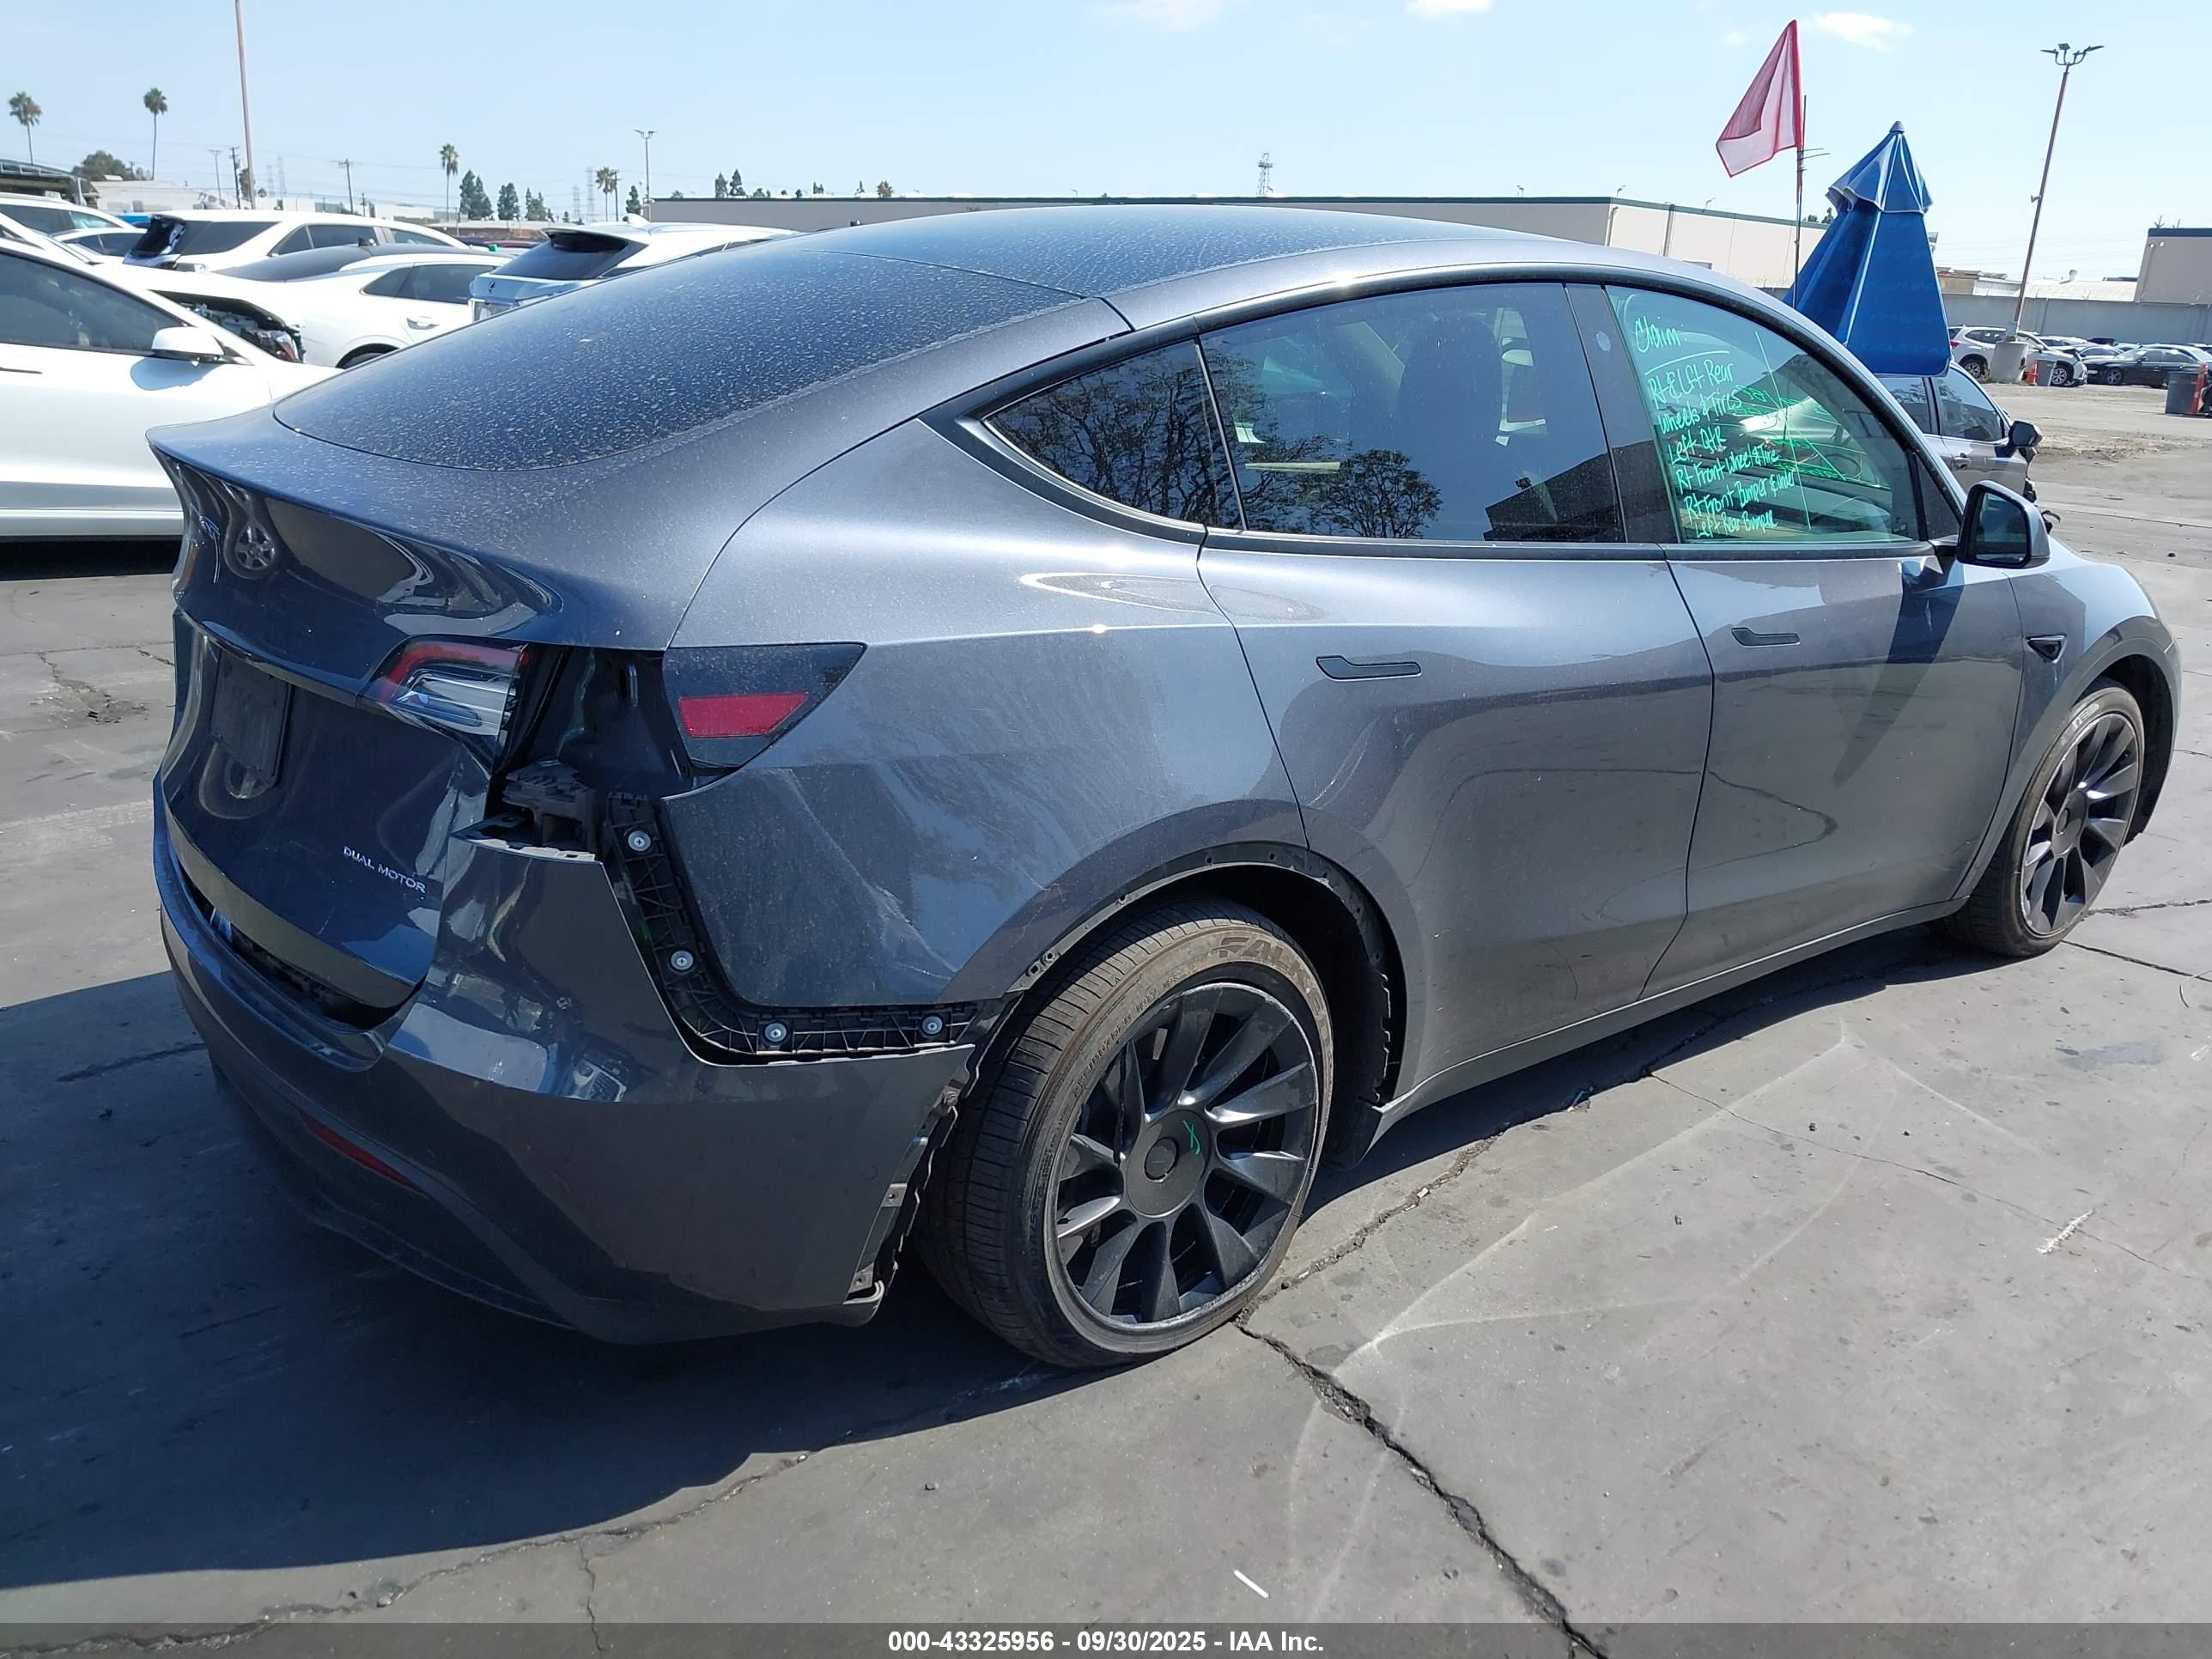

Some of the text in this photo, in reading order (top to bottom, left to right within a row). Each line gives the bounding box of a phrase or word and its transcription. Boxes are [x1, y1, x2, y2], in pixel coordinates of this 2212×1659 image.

[1668, 429, 1697, 465] Left
[1693, 459, 1726, 487] Front
[1735, 480, 1767, 508] Bumper
[343, 846, 426, 894] DUAL MOTOR
